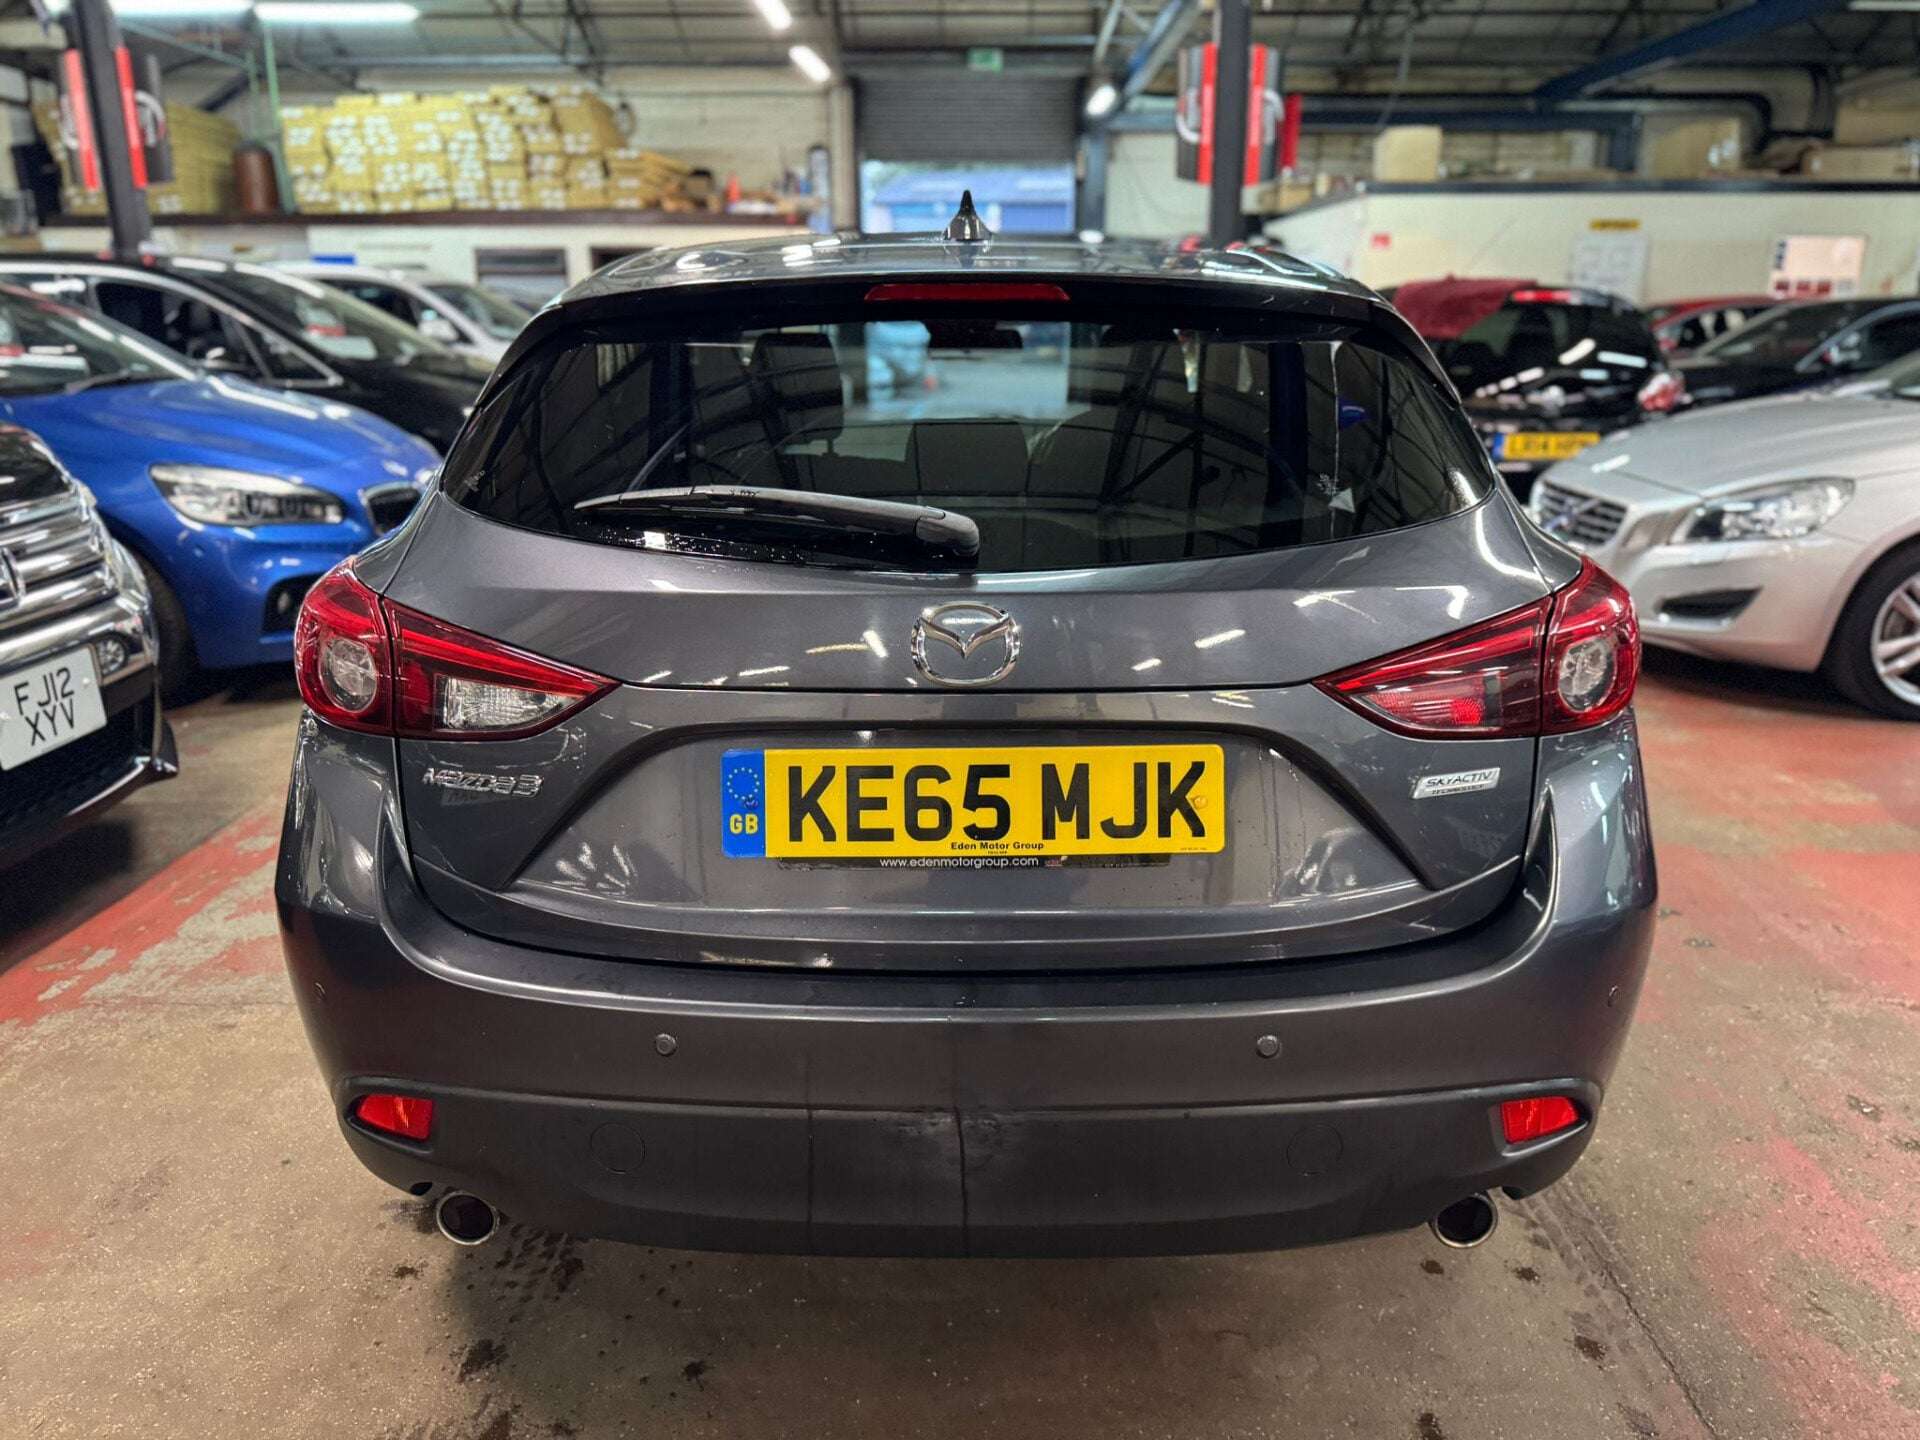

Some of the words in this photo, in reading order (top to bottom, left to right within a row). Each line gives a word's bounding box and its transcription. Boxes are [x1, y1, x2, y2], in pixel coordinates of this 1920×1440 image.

[14, 667, 75, 716] FJ12
[24, 698, 75, 747] XYV
[1425, 771, 1493, 788] SKYACTIV
[788, 764, 1011, 843] KE65
[1041, 761, 1206, 841] MJK
[729, 813, 759, 835] GB
[951, 842, 977, 850] Eden
[980, 842, 1009, 850] Motor
[1012, 841, 1044, 851] Group
[880, 855, 1039, 869] www.edenmotorgroup.com
